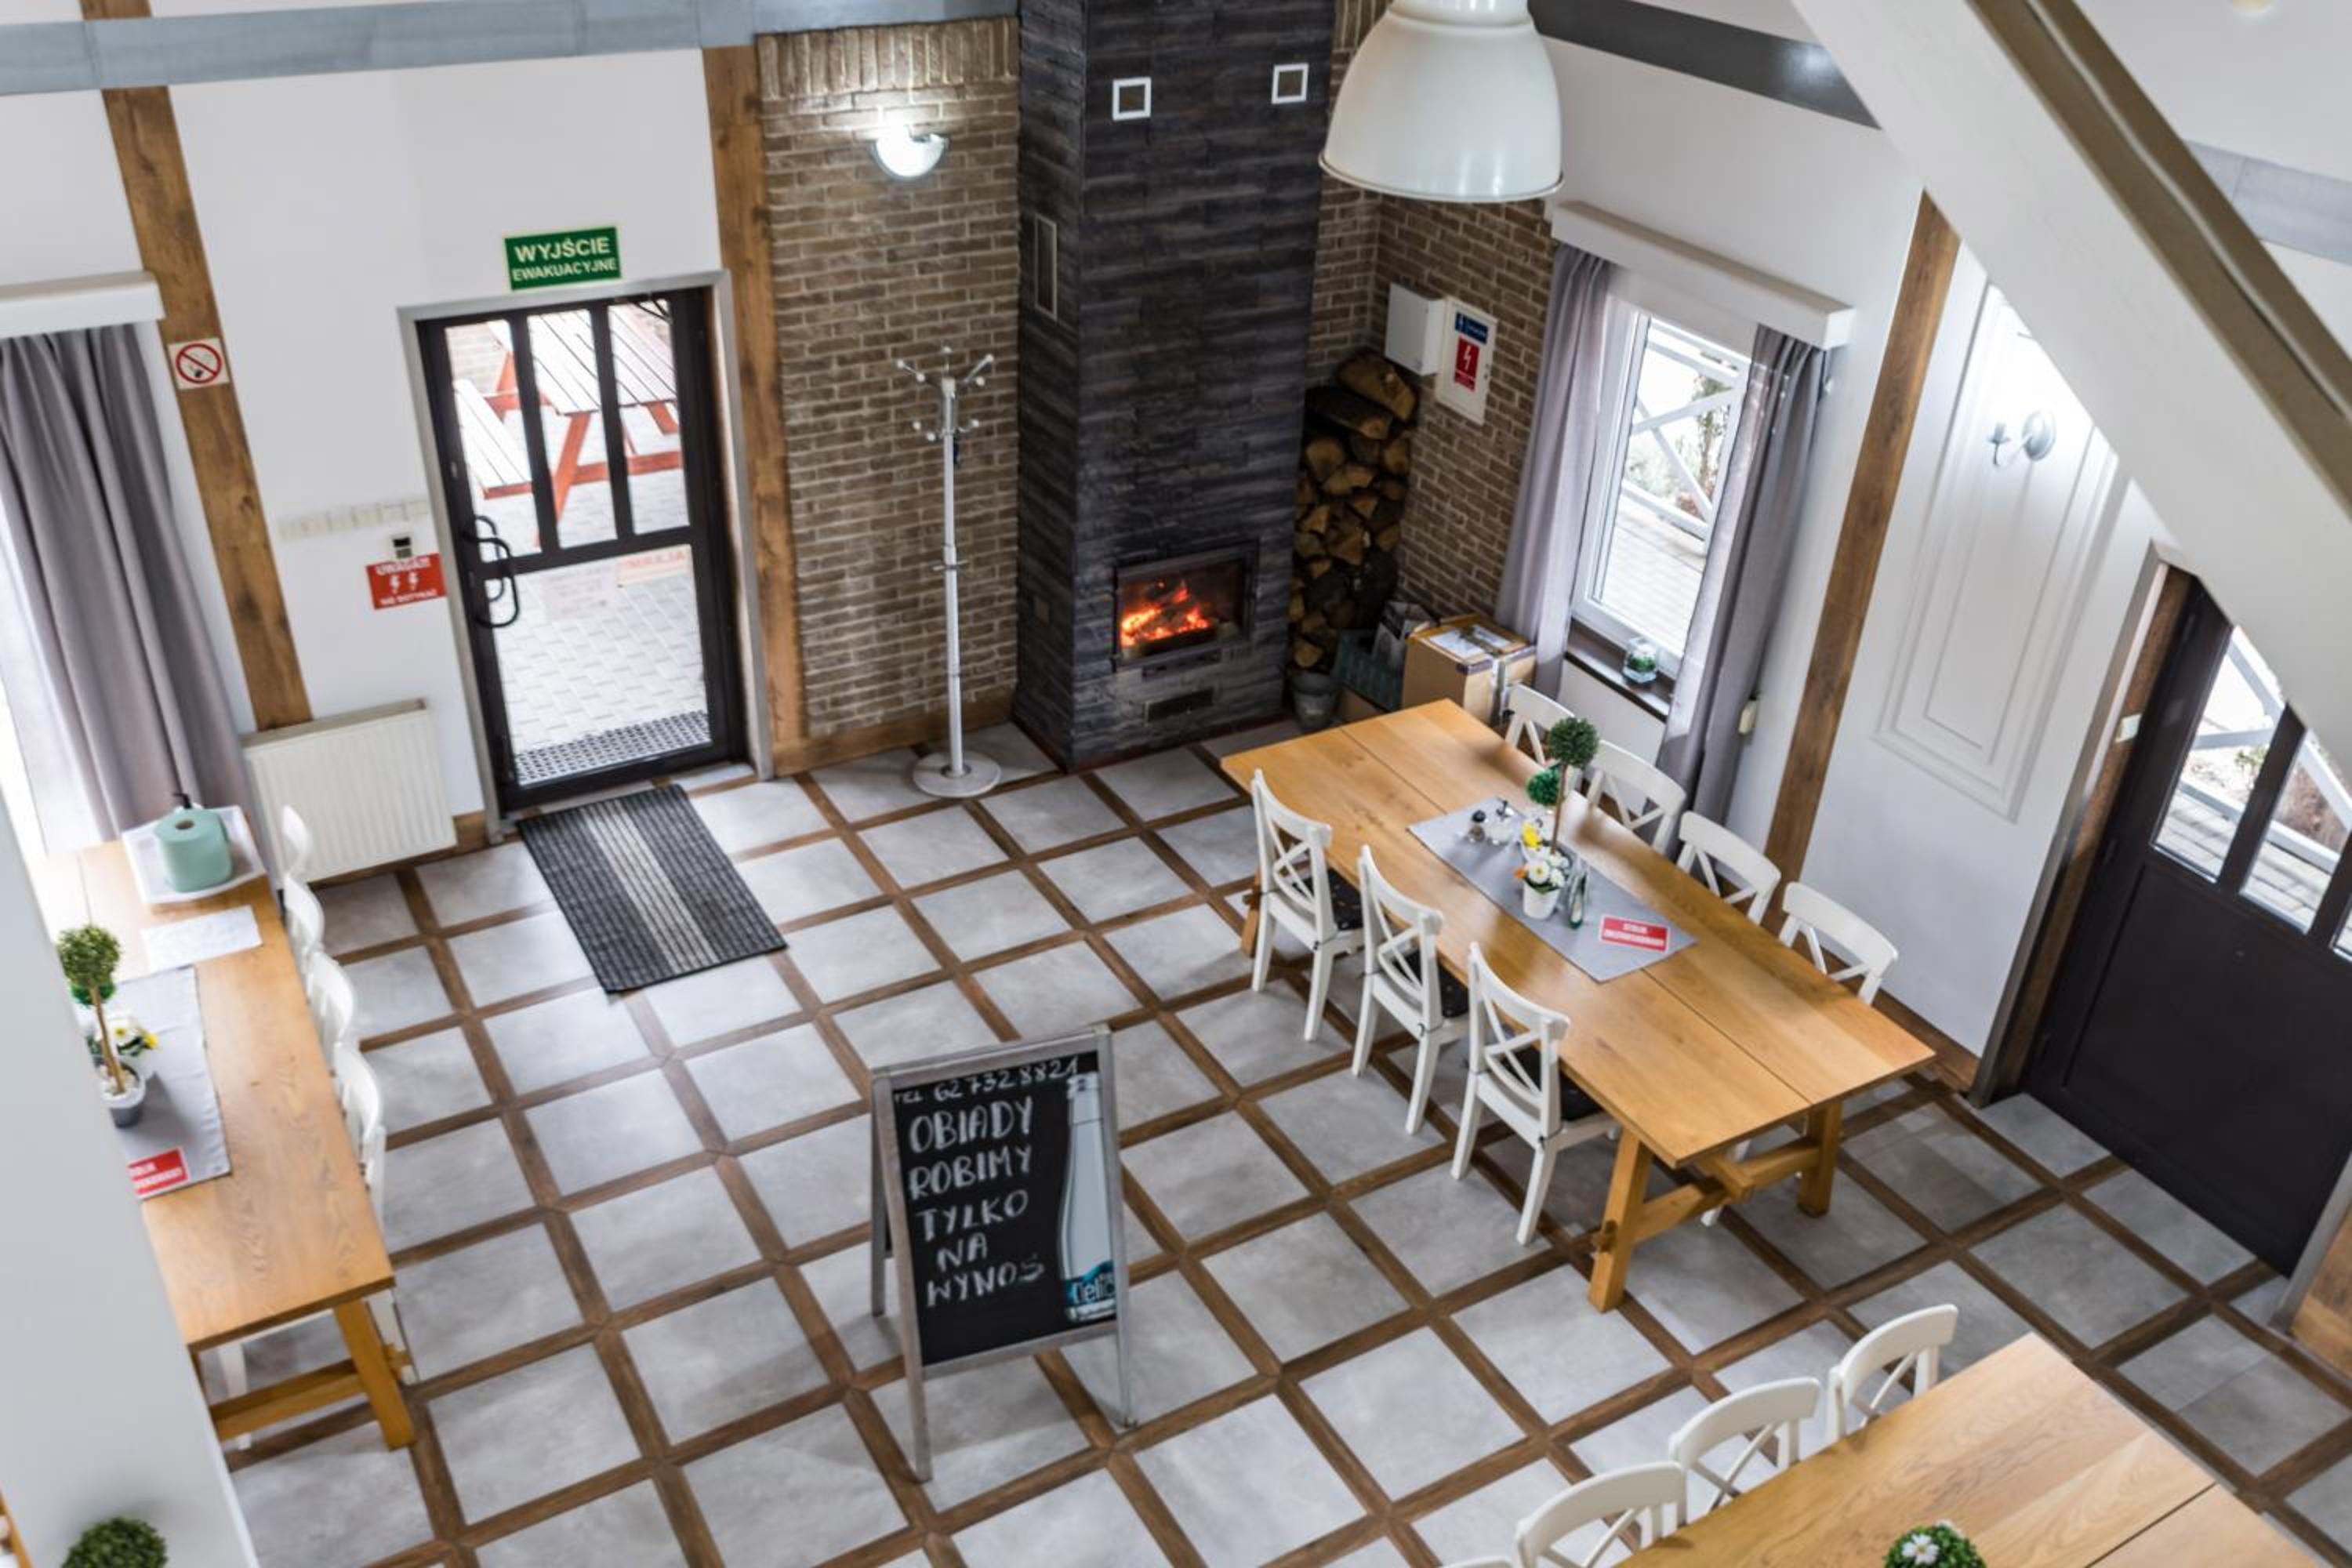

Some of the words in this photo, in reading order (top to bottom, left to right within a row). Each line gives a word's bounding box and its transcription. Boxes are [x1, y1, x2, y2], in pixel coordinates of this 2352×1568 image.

[512, 257, 617, 281] EWAKUACYJNE
[514, 237, 611, 263] WYJŚCIE
[934, 1080, 963, 1102] 62
[965, 1069, 1015, 1094] 732
[1019, 1056, 1078, 1085] 8821
[909, 1095, 1033, 1153] OBIADY
[908, 1144, 1032, 1200] ROBIMY
[916, 1189, 1029, 1242] TYLKO
[937, 1232, 988, 1272] NA
[927, 1254, 1045, 1308] WYNOS
